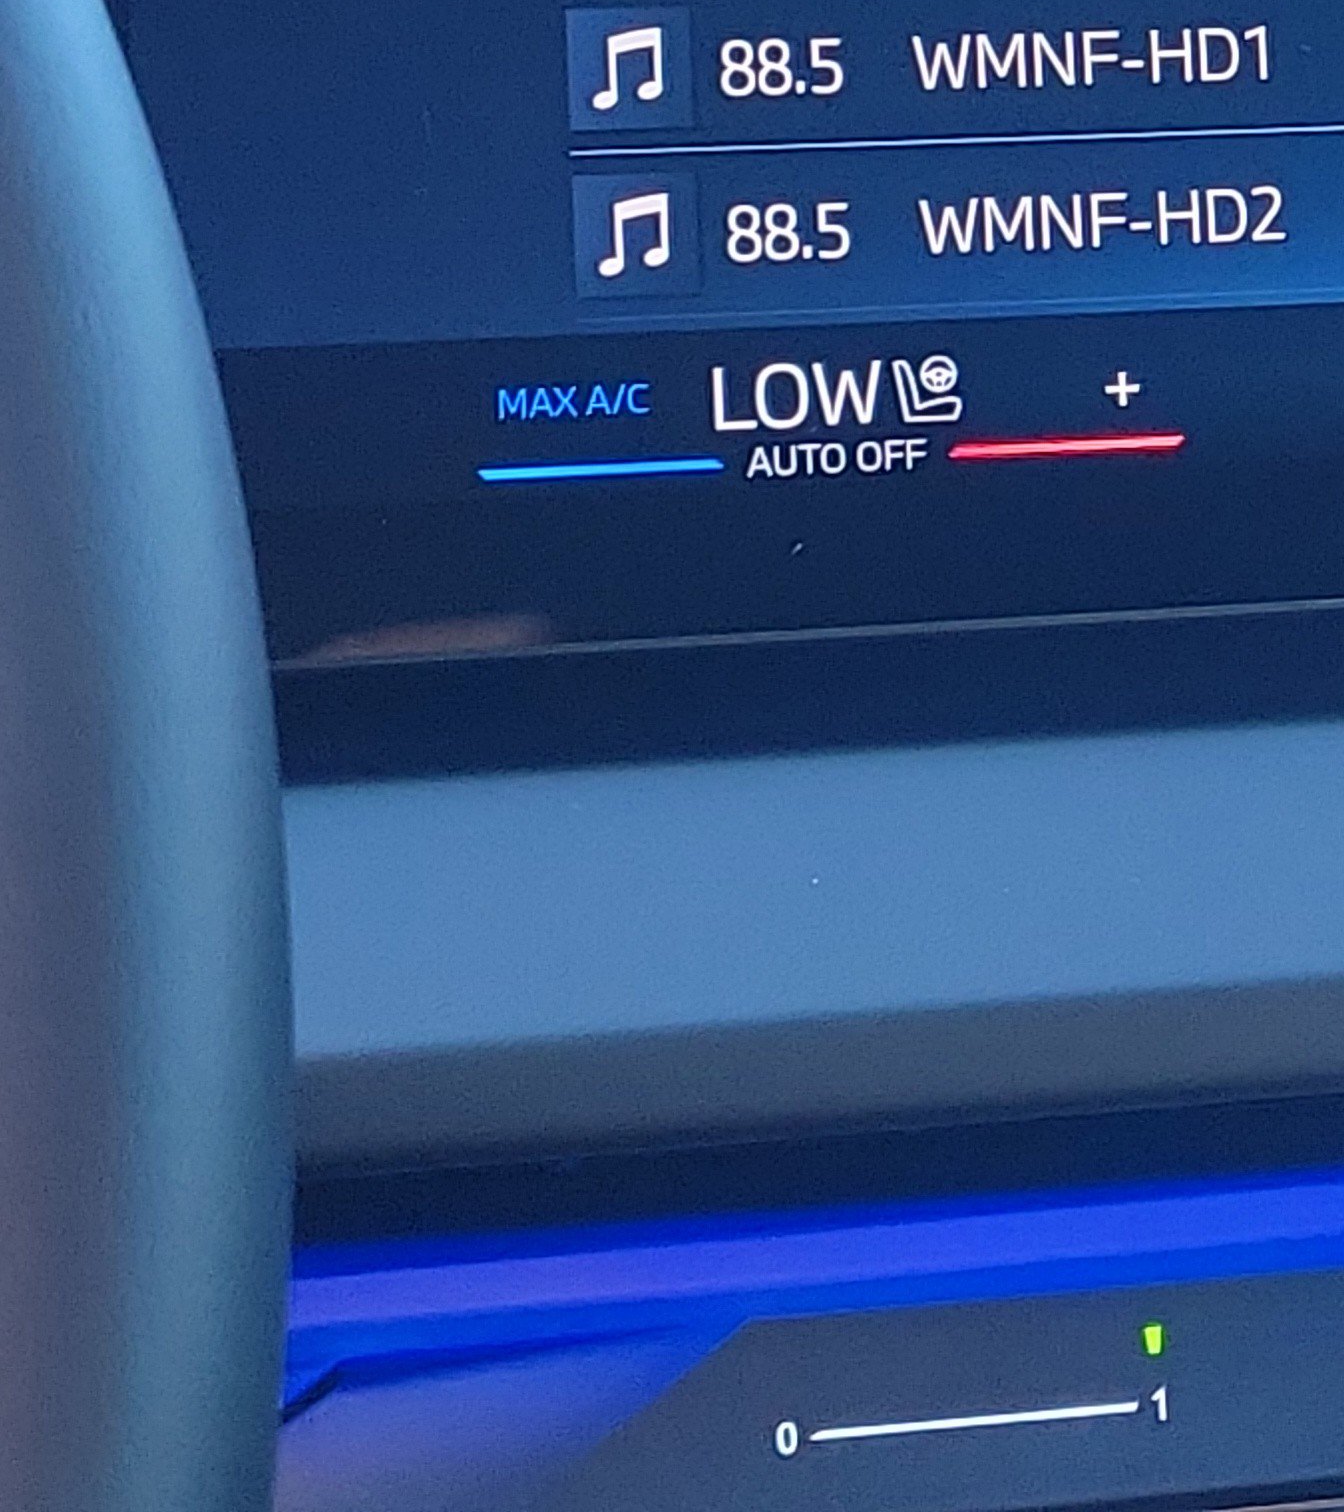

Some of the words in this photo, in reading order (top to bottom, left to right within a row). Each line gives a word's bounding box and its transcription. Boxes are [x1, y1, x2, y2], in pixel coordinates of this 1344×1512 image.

[719, 38, 844, 97] 88.5
[911, 25, 1271, 90] WMNF-HD1
[725, 203, 851, 263] 88.5
[918, 186, 1287, 256] WMNF-HD2
[498, 388, 577, 420] MAX
[585, 383, 650, 416] A/C
[712, 360, 882, 431] LOW
[745, 442, 848, 480] AUTO
[856, 438, 928, 473] OFF
[1149, 1386, 1170, 1423] 1
[774, 1421, 799, 1455] 0
